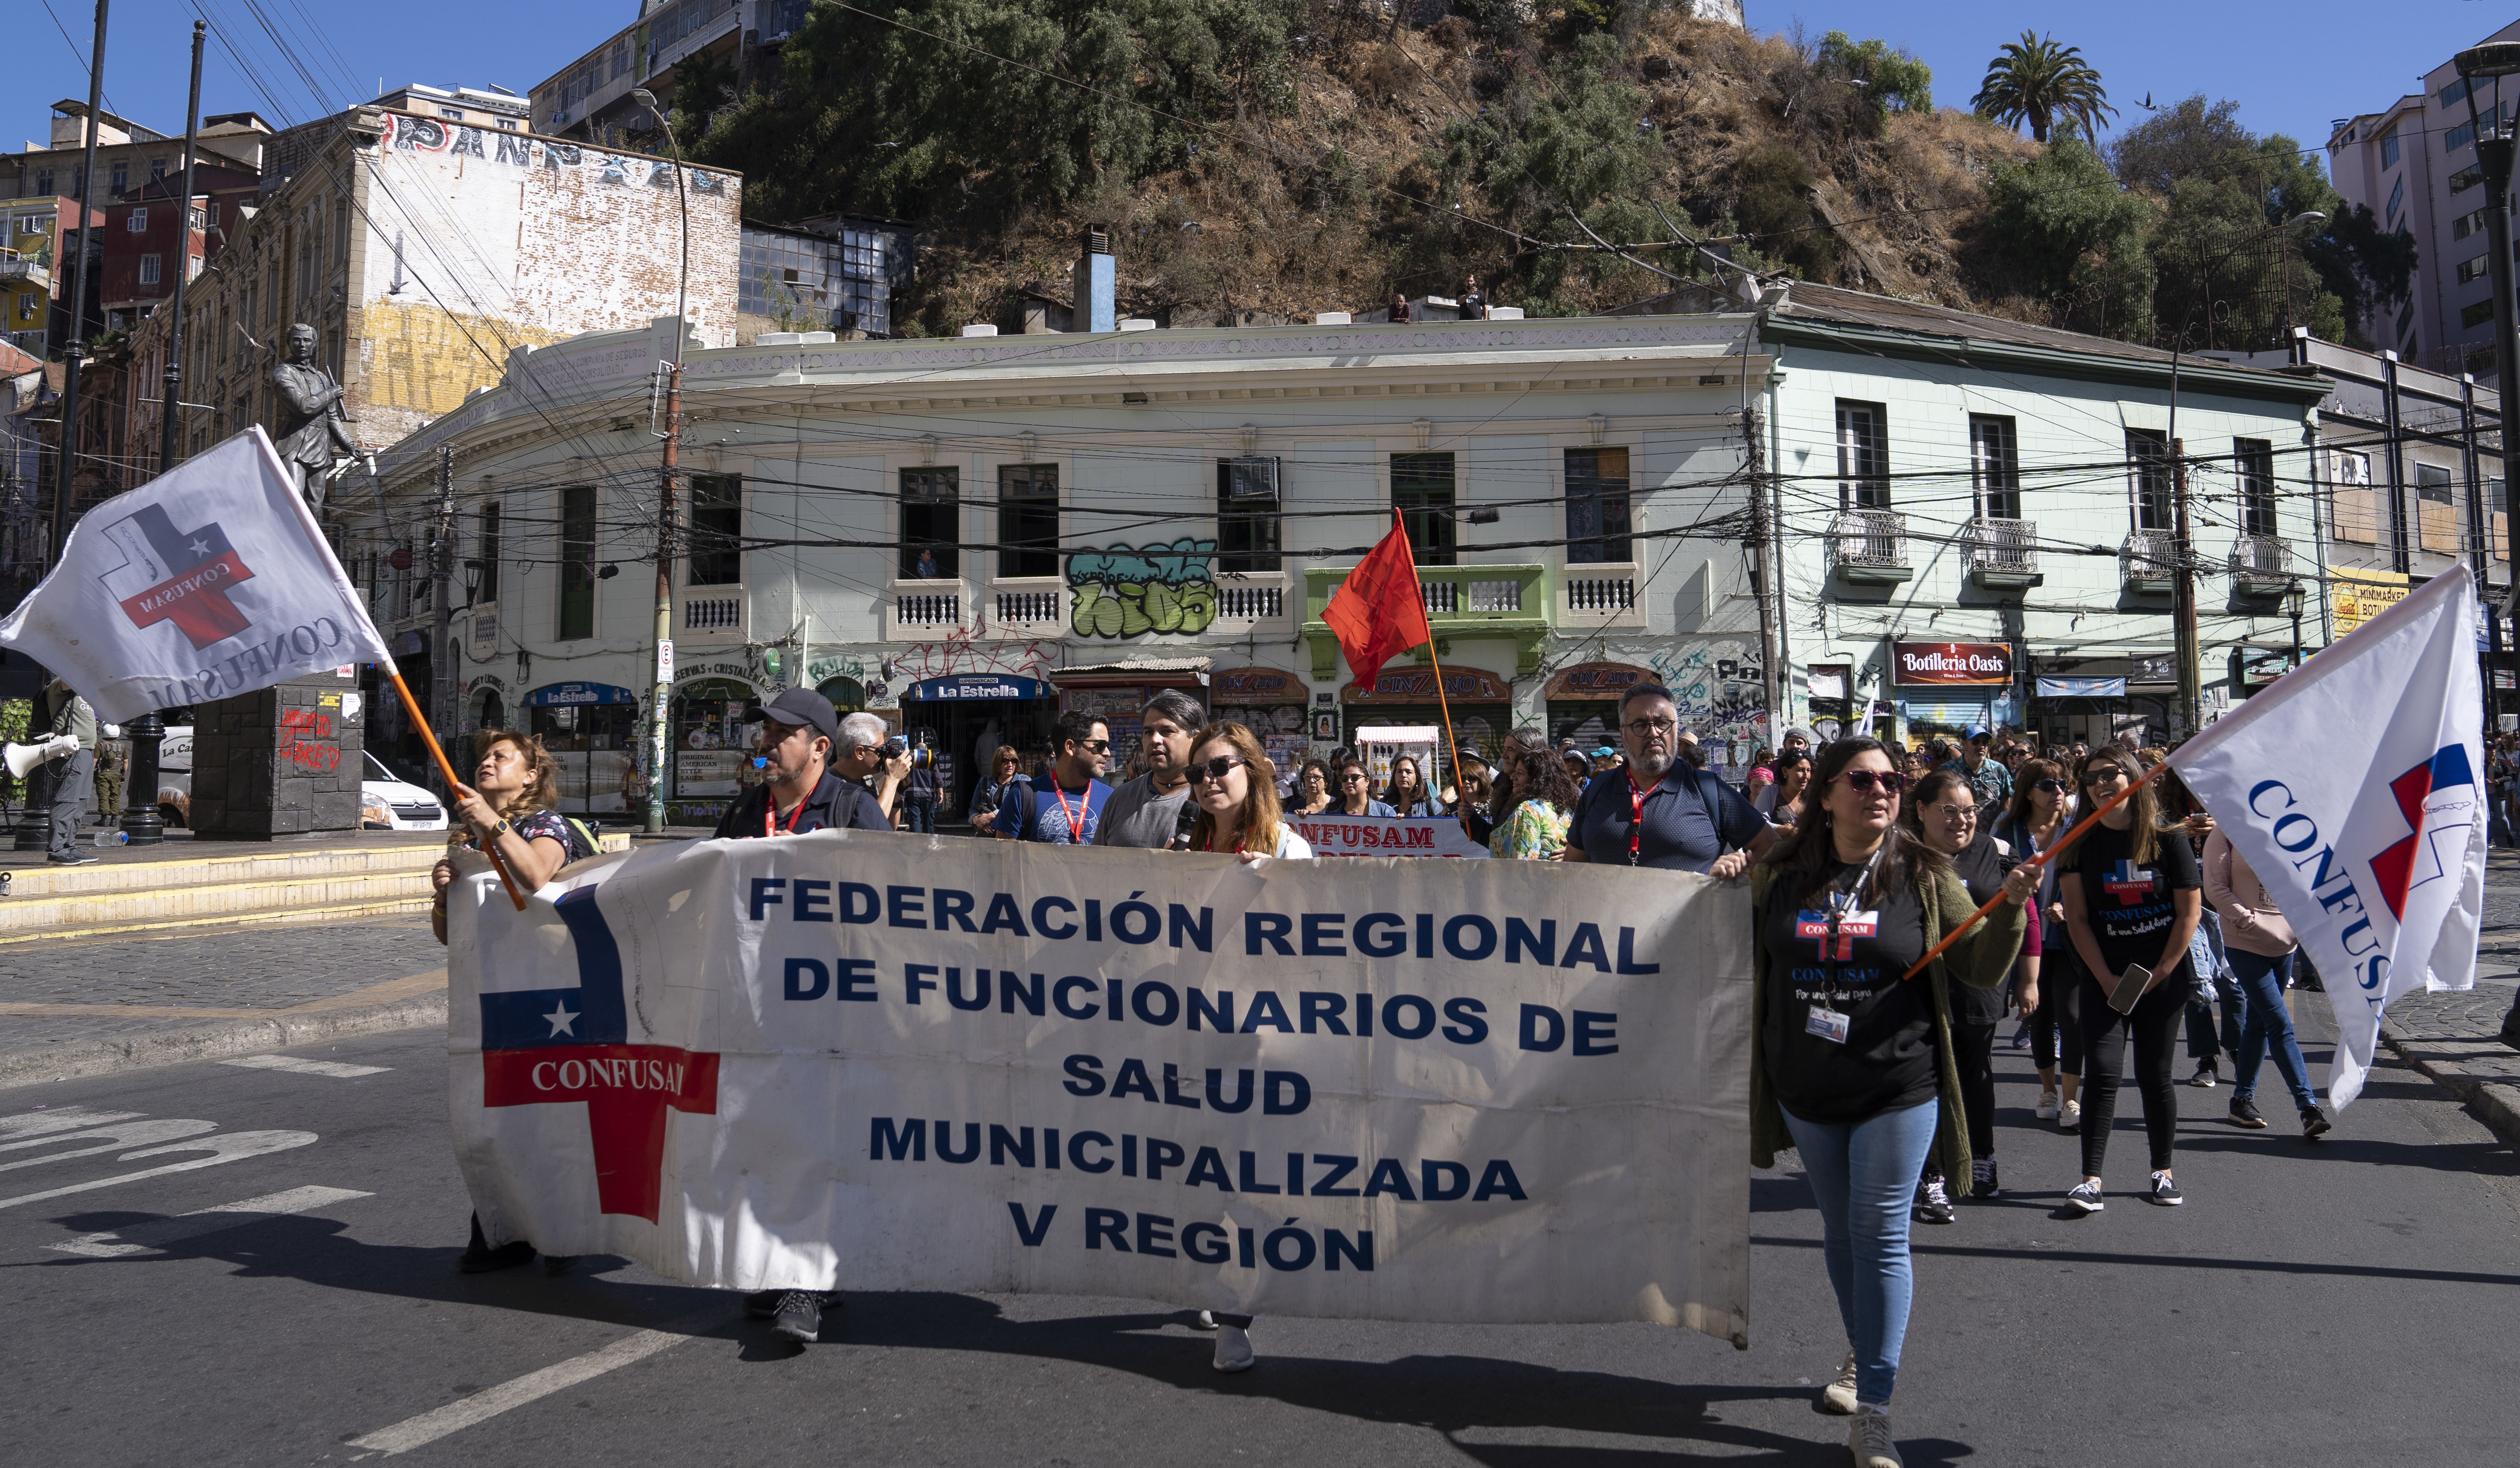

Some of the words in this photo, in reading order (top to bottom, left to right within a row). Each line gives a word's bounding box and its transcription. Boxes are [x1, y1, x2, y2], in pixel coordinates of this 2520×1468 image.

[615, 348, 647, 360] SEGUROS
[1903, 652, 1967, 671] Botilleria
[1969, 654, 2003, 672] Oasis
[485, 674, 505, 692] LICORES
[1219, 674, 1285, 691] CINZANO
[1377, 674, 1475, 696] CINZANO
[1569, 669, 1638, 687] CINZANO
[548, 692, 559, 703] La
[560, 691, 598, 703] Estrella
[938, 686, 956, 698] La
[960, 685, 1019, 697] Estrella
[280, 708, 331, 737] ABORTO
[162, 749, 174, 758] La
[279, 733, 325, 768] LIBRE
[2249, 779, 2392, 1017] CONFUS
[2099, 901, 2172, 921] CONFUSAM
[750, 877, 1213, 953] FEDERACIÓN
[1244, 912, 1660, 975] REGIONAL
[1805, 925, 1868, 934] CONUSAM
[2107, 924, 2117, 936] Por
[2133, 921, 2154, 934] Salud
[2154, 916, 2173, 929] digna
[1791, 967, 1880, 981] CONUSAM
[1796, 989, 1810, 1000] Por
[784, 958, 879, 1002] DE
[904, 962, 1489, 1044] FUNCIONARIOS
[1519, 1003, 1619, 1056] DE
[1062, 1053, 1312, 1115] SALUD
[870, 1116, 1528, 1201] MUNICIPALIZADA
[1008, 1201, 1058, 1247] V
[1084, 1207, 1373, 1272] REGIÓN
